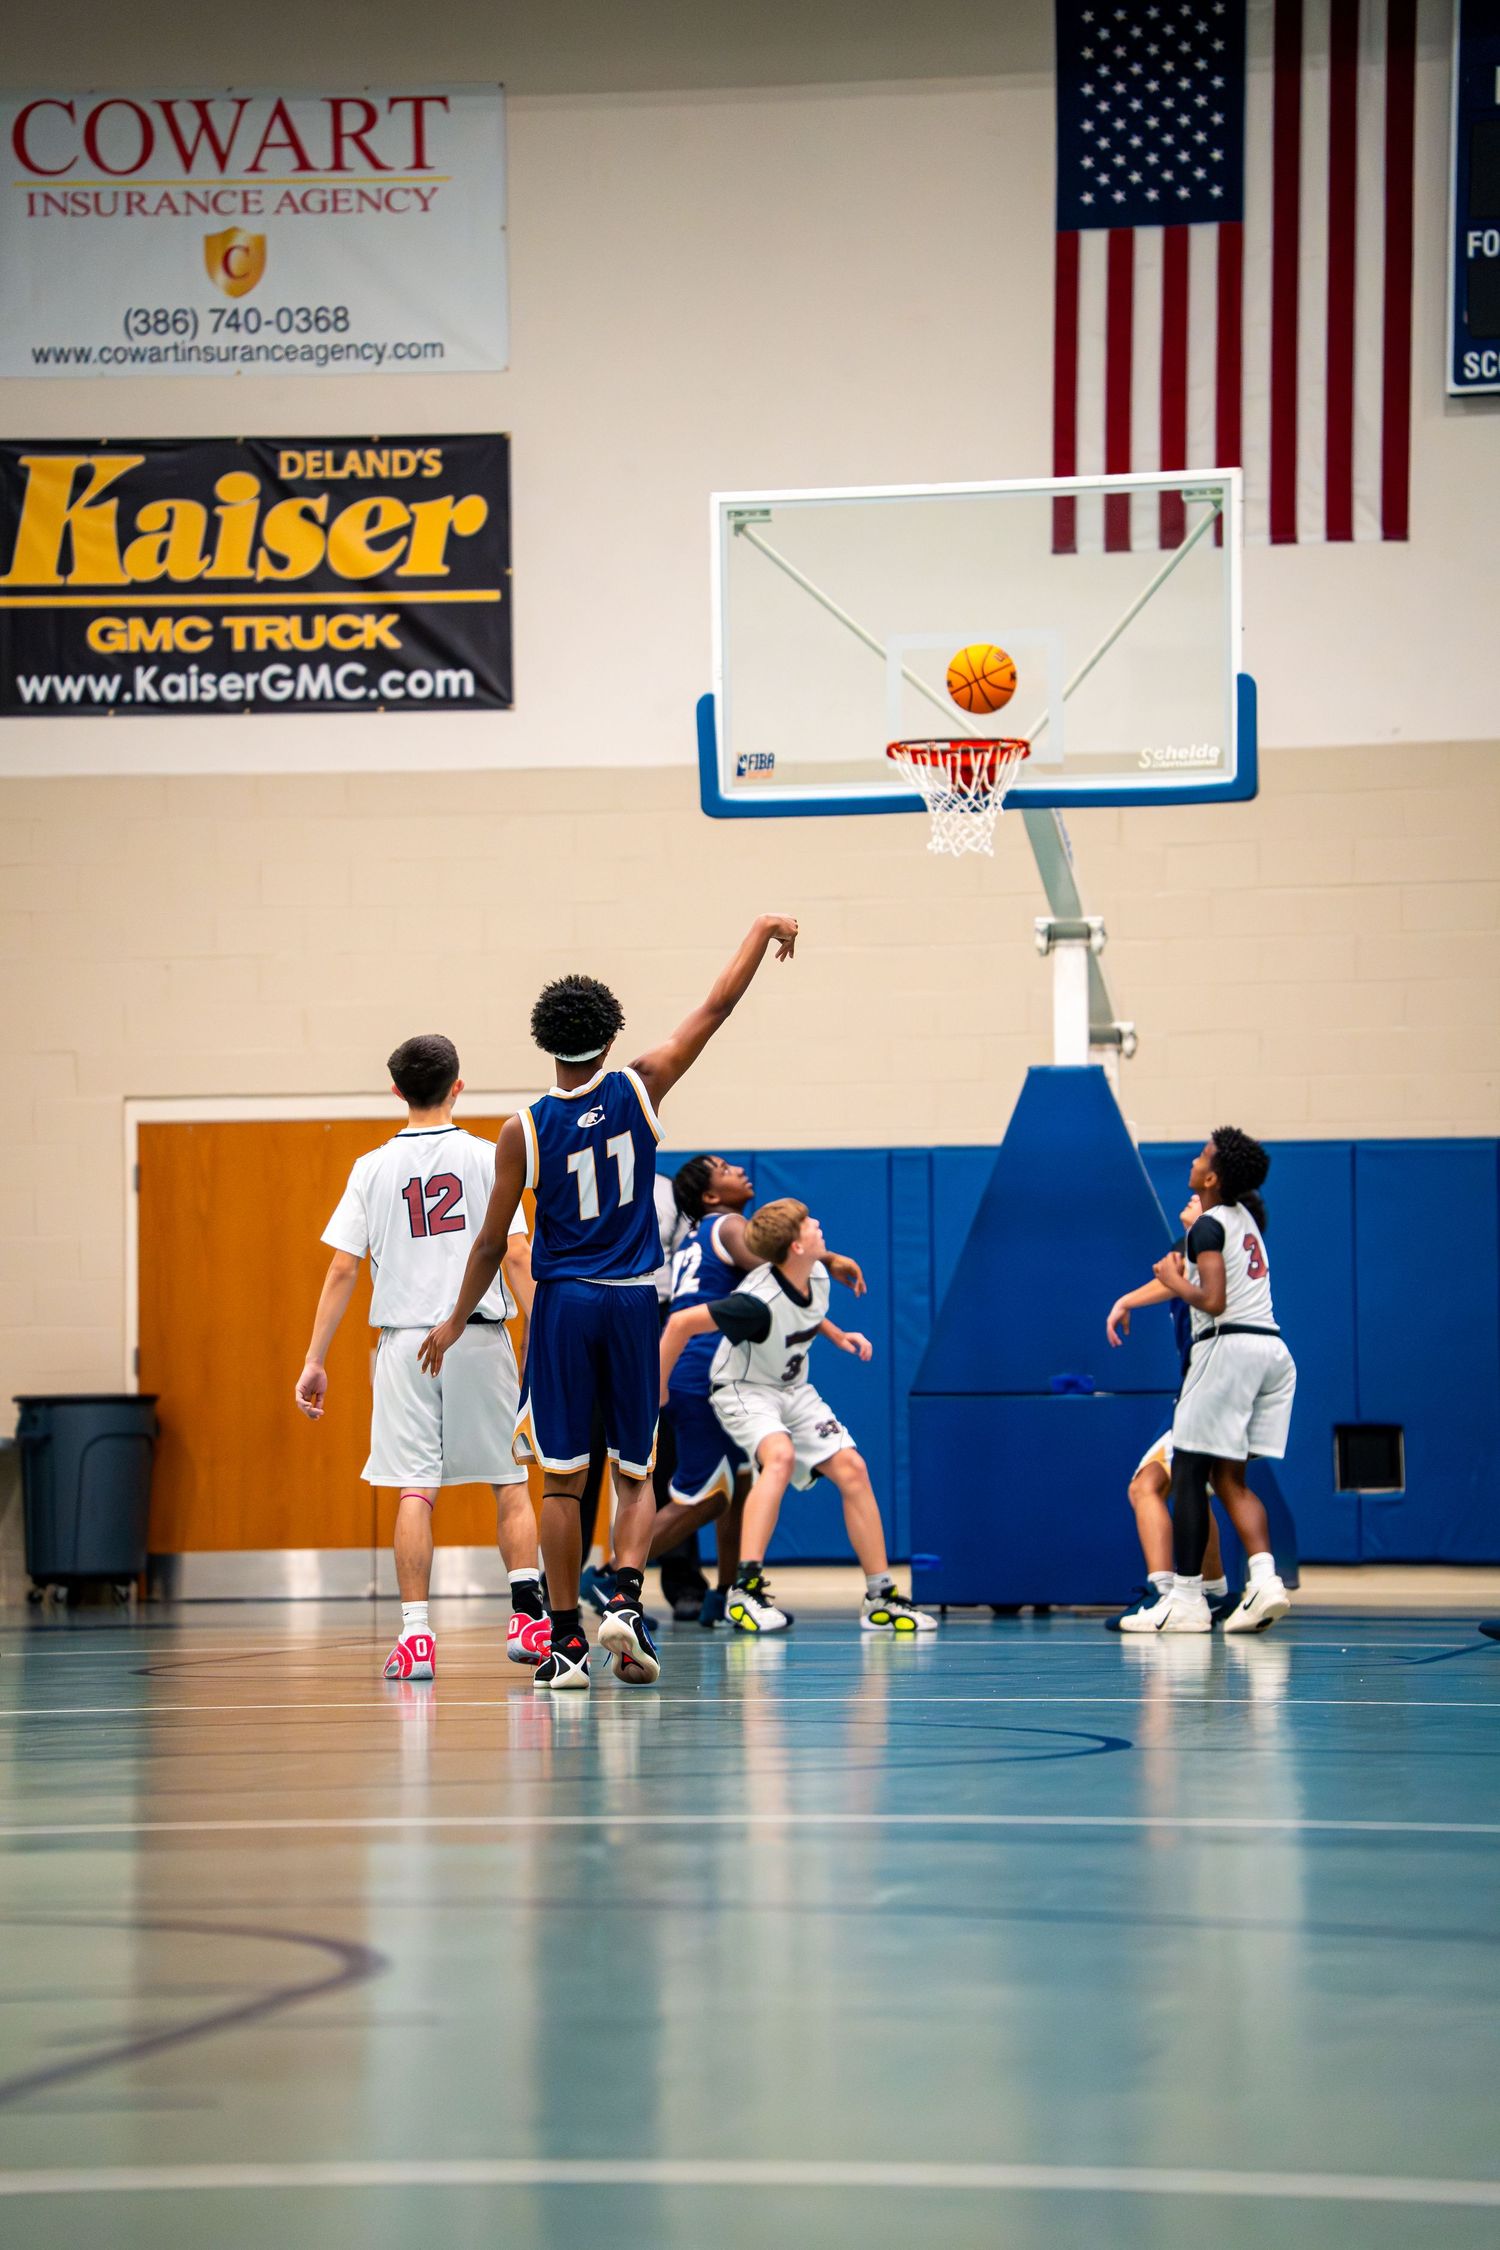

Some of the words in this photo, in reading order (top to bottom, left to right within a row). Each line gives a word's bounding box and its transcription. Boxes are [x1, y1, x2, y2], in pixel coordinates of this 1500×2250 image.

[12, 96, 451, 175] COWART
[27, 189, 264, 218] INSURANCE
[274, 187, 440, 215] AGENCY
[221, 245, 251, 280] C
[123, 308, 199, 341] (386)
[209, 306, 351, 336] 740-0368
[32, 340, 445, 367] www.cowartinsuranceagency.com
[1463, 350, 1500, 379] SC
[278, 449, 443, 479] DELAND'S
[0, 455, 489, 586] Kaiser
[87, 617, 213, 653] GMC
[222, 614, 402, 652] TRUCK
[17, 664, 475, 704] www.KaiserGMC.com
[567, 1130, 636, 1221] 11
[402, 1172, 466, 1238] 12
[1243, 1233, 1269, 1280] 3
